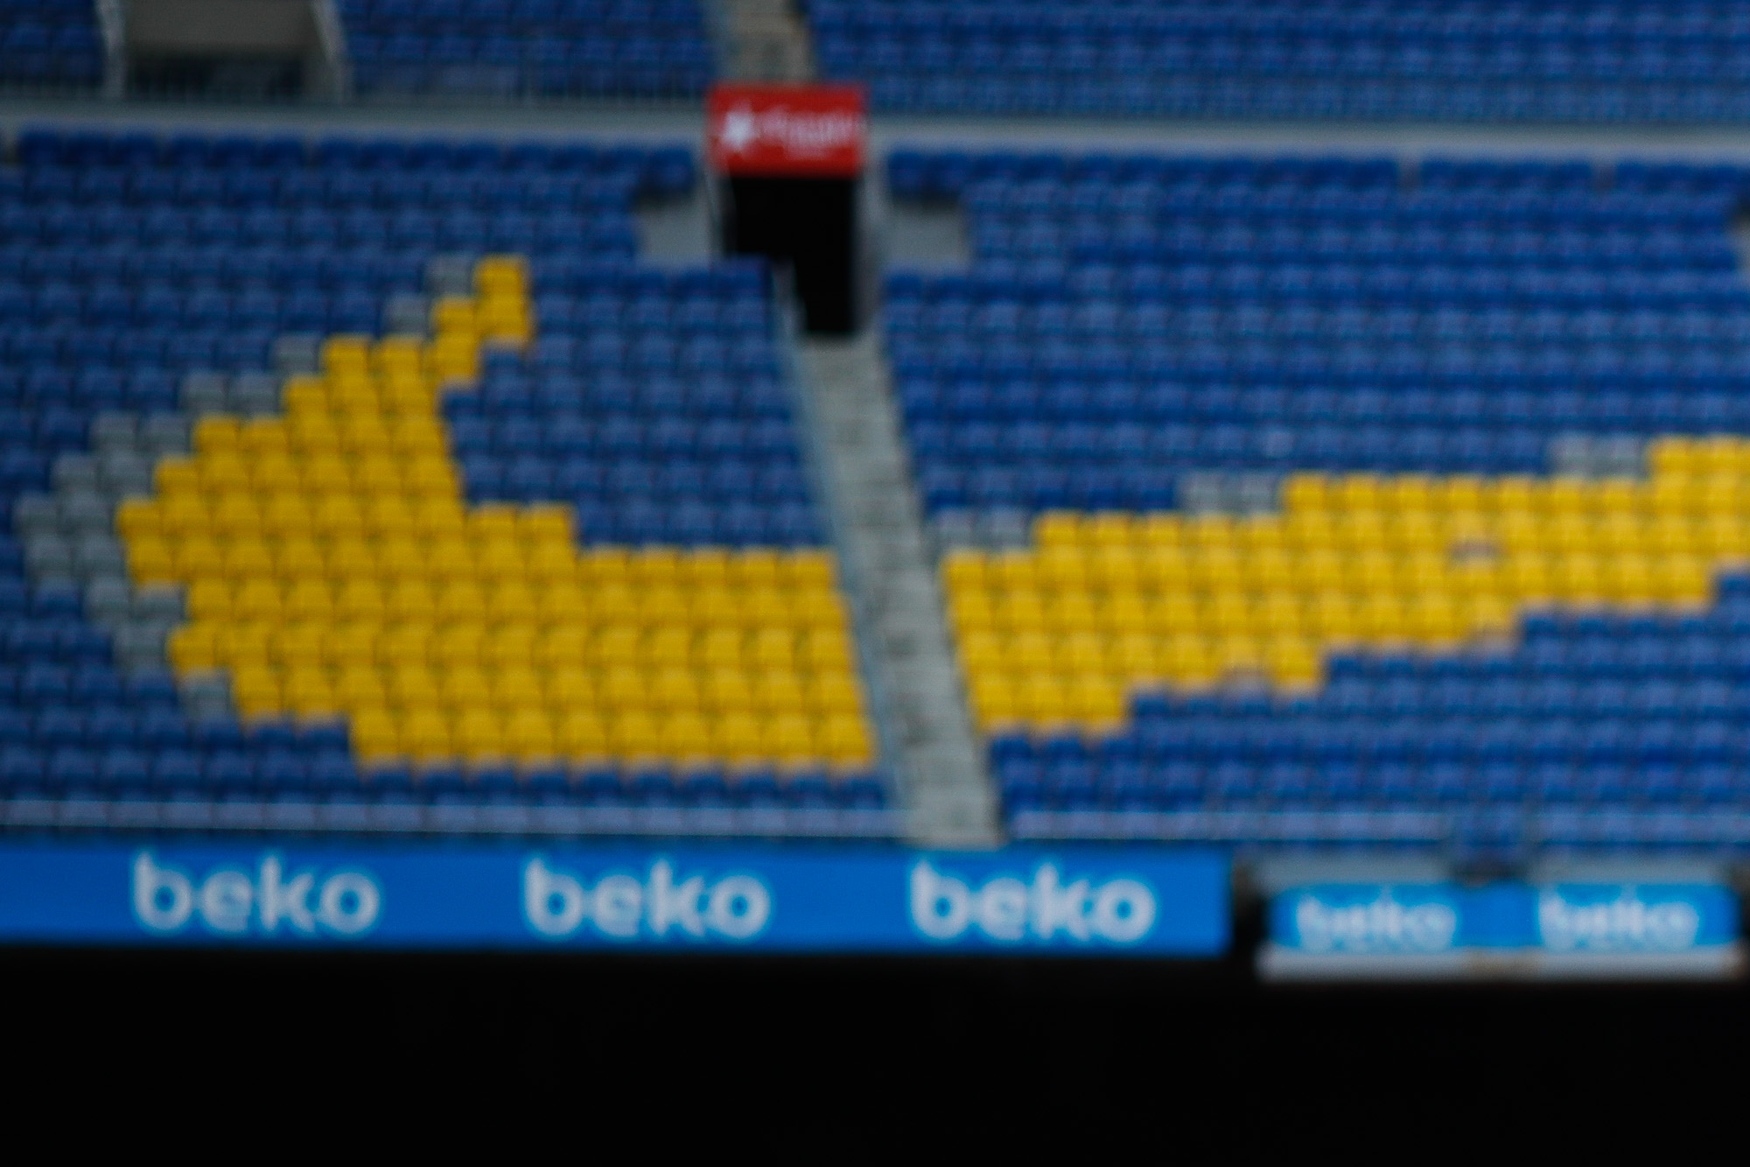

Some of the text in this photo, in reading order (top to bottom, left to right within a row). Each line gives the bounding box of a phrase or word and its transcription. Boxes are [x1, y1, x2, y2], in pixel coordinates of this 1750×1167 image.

[134, 855, 1156, 942] beko beko beko
